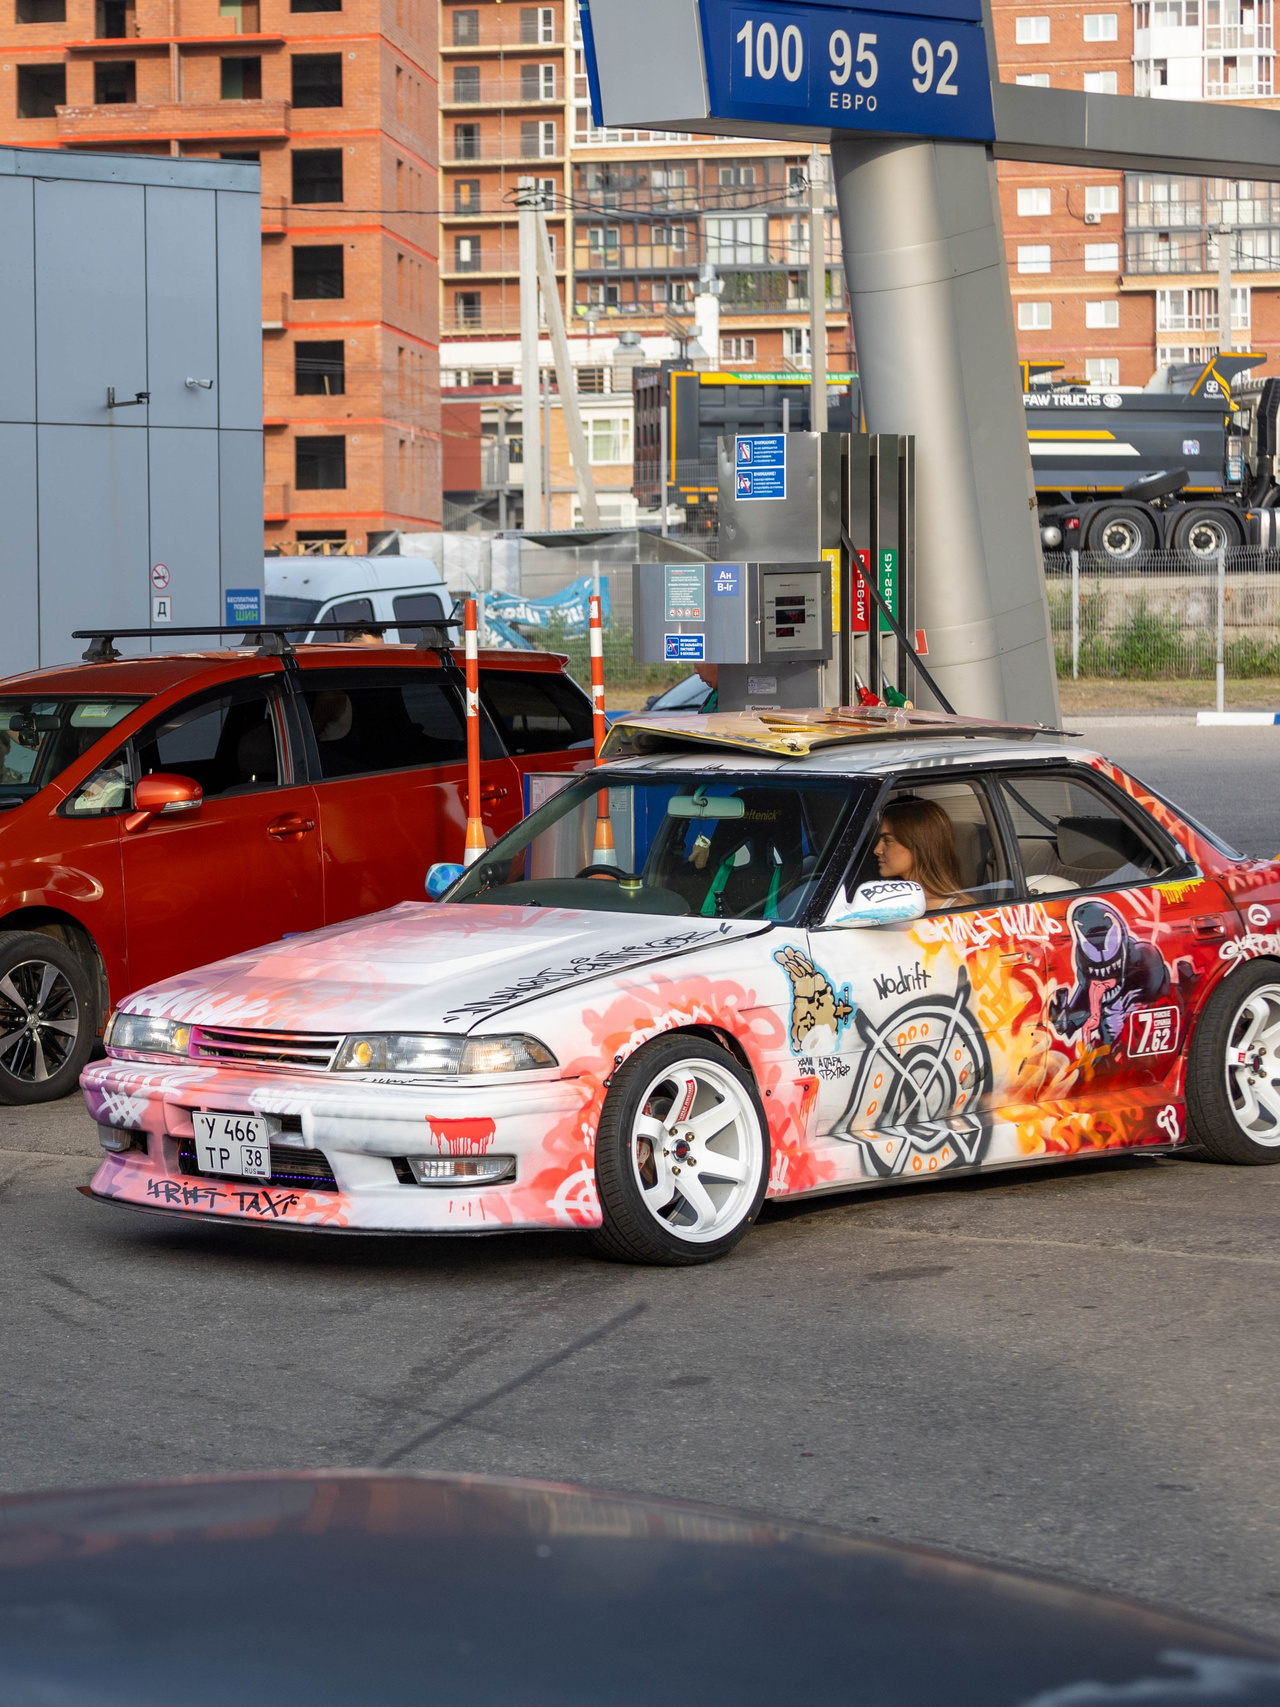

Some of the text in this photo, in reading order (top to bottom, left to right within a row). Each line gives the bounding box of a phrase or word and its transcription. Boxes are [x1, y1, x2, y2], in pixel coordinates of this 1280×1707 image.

[736, 20, 959, 96] 100 95 92
[829, 92, 878, 112] ЕВРО
[1022, 394, 1101, 406] FAW TRUCKS
[719, 571, 732, 579] Ан
[157, 601, 167, 617] Д
[235, 611, 258, 621] ШИН
[224, 1117, 256, 1143] 466
[205, 1146, 231, 1170] ТР
[245, 1149, 263, 1167] 38
[244, 1167, 257, 1175] RUS
